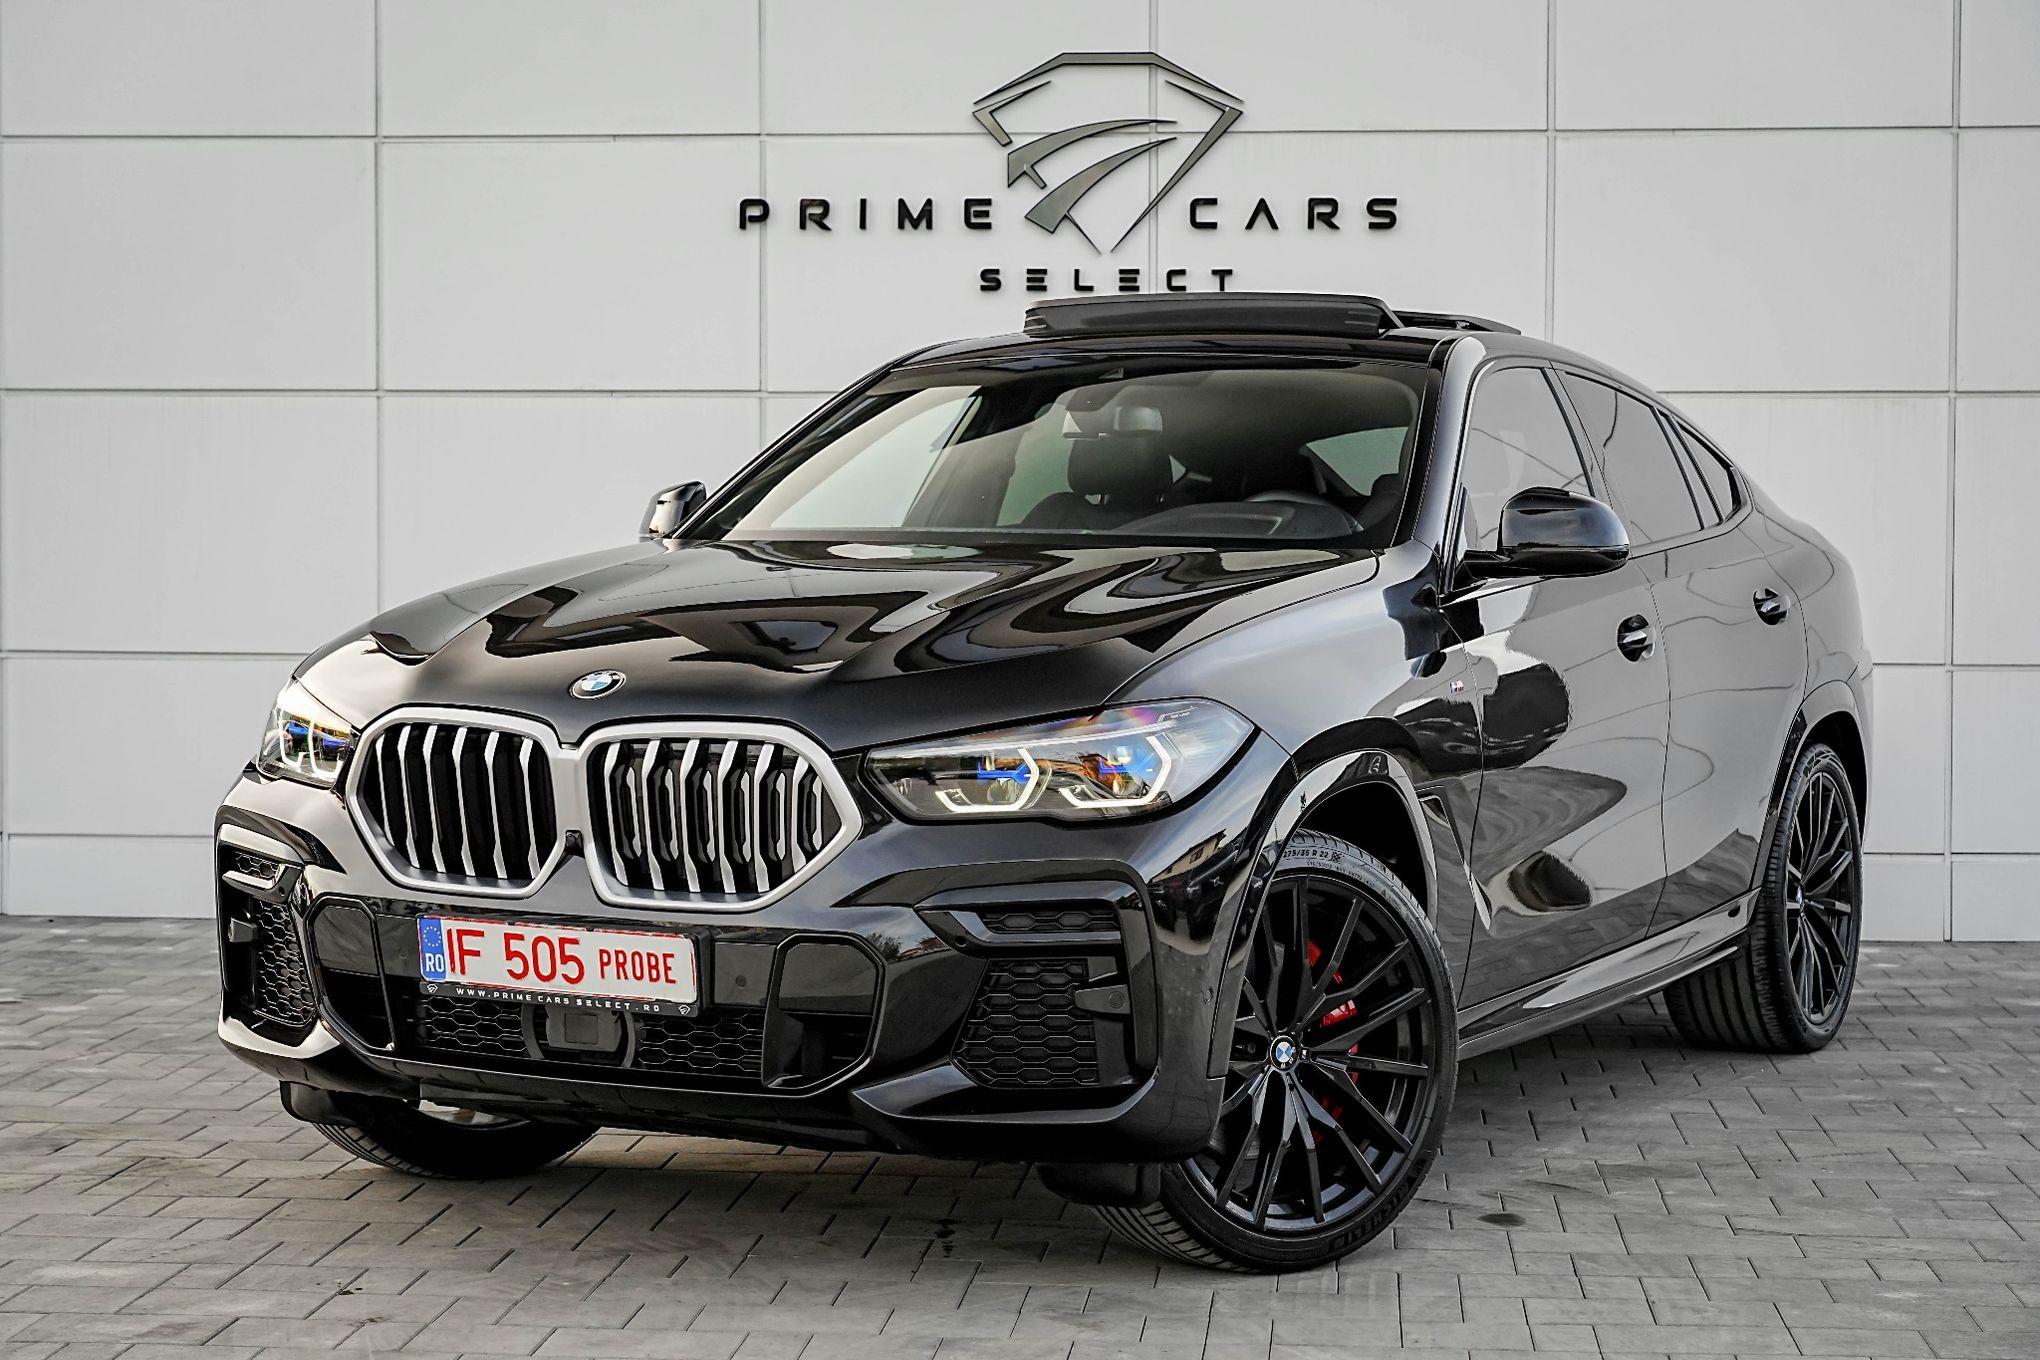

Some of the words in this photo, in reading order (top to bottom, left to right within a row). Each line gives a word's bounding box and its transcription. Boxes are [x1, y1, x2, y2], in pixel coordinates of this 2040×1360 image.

[739, 198, 993, 231] PRIME
[1189, 197, 1398, 231] CARS
[979, 269, 1233, 293] SELECT
[425, 952, 445, 973] RO
[447, 928, 485, 975] IF
[503, 932, 585, 985] 505
[598, 948, 677, 984] PROBE
